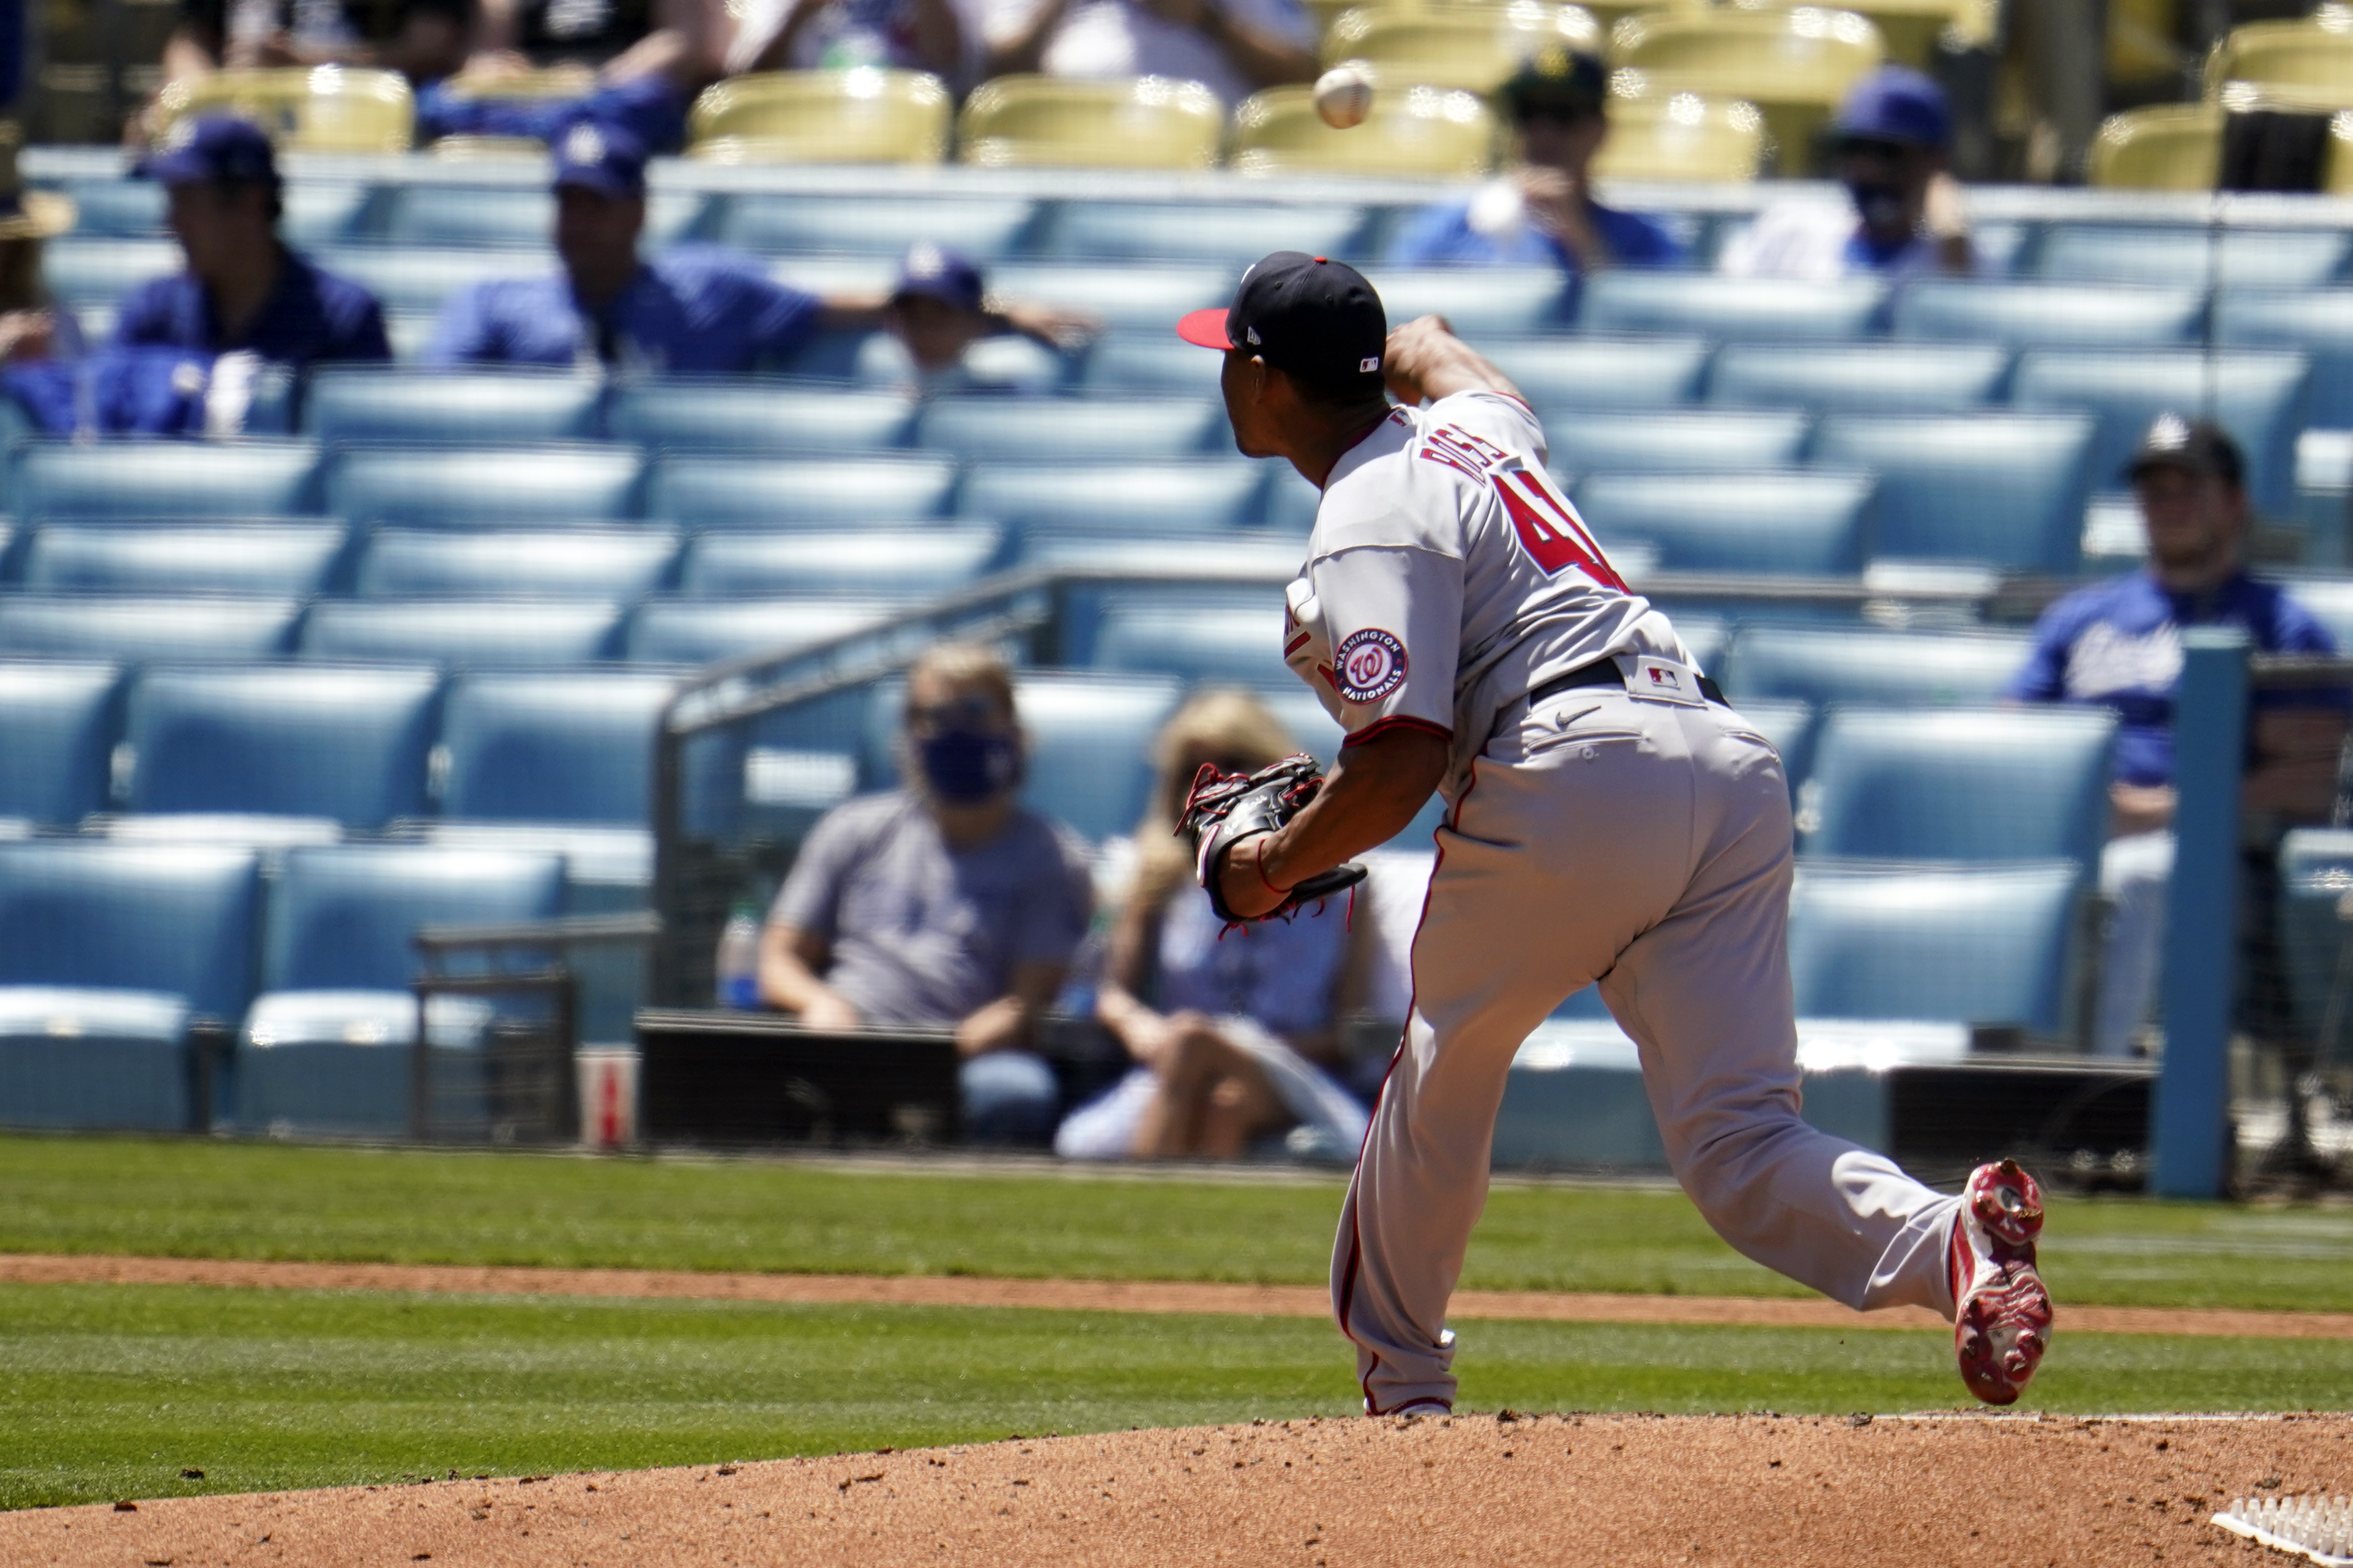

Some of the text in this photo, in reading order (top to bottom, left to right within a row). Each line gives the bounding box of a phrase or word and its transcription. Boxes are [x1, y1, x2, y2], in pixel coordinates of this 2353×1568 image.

[1420, 423, 1509, 488] ROSS
[1490, 469, 1634, 596] 41
[1336, 631, 1401, 671] WASHINGTON
[1342, 669, 1402, 701] NATIONALS
